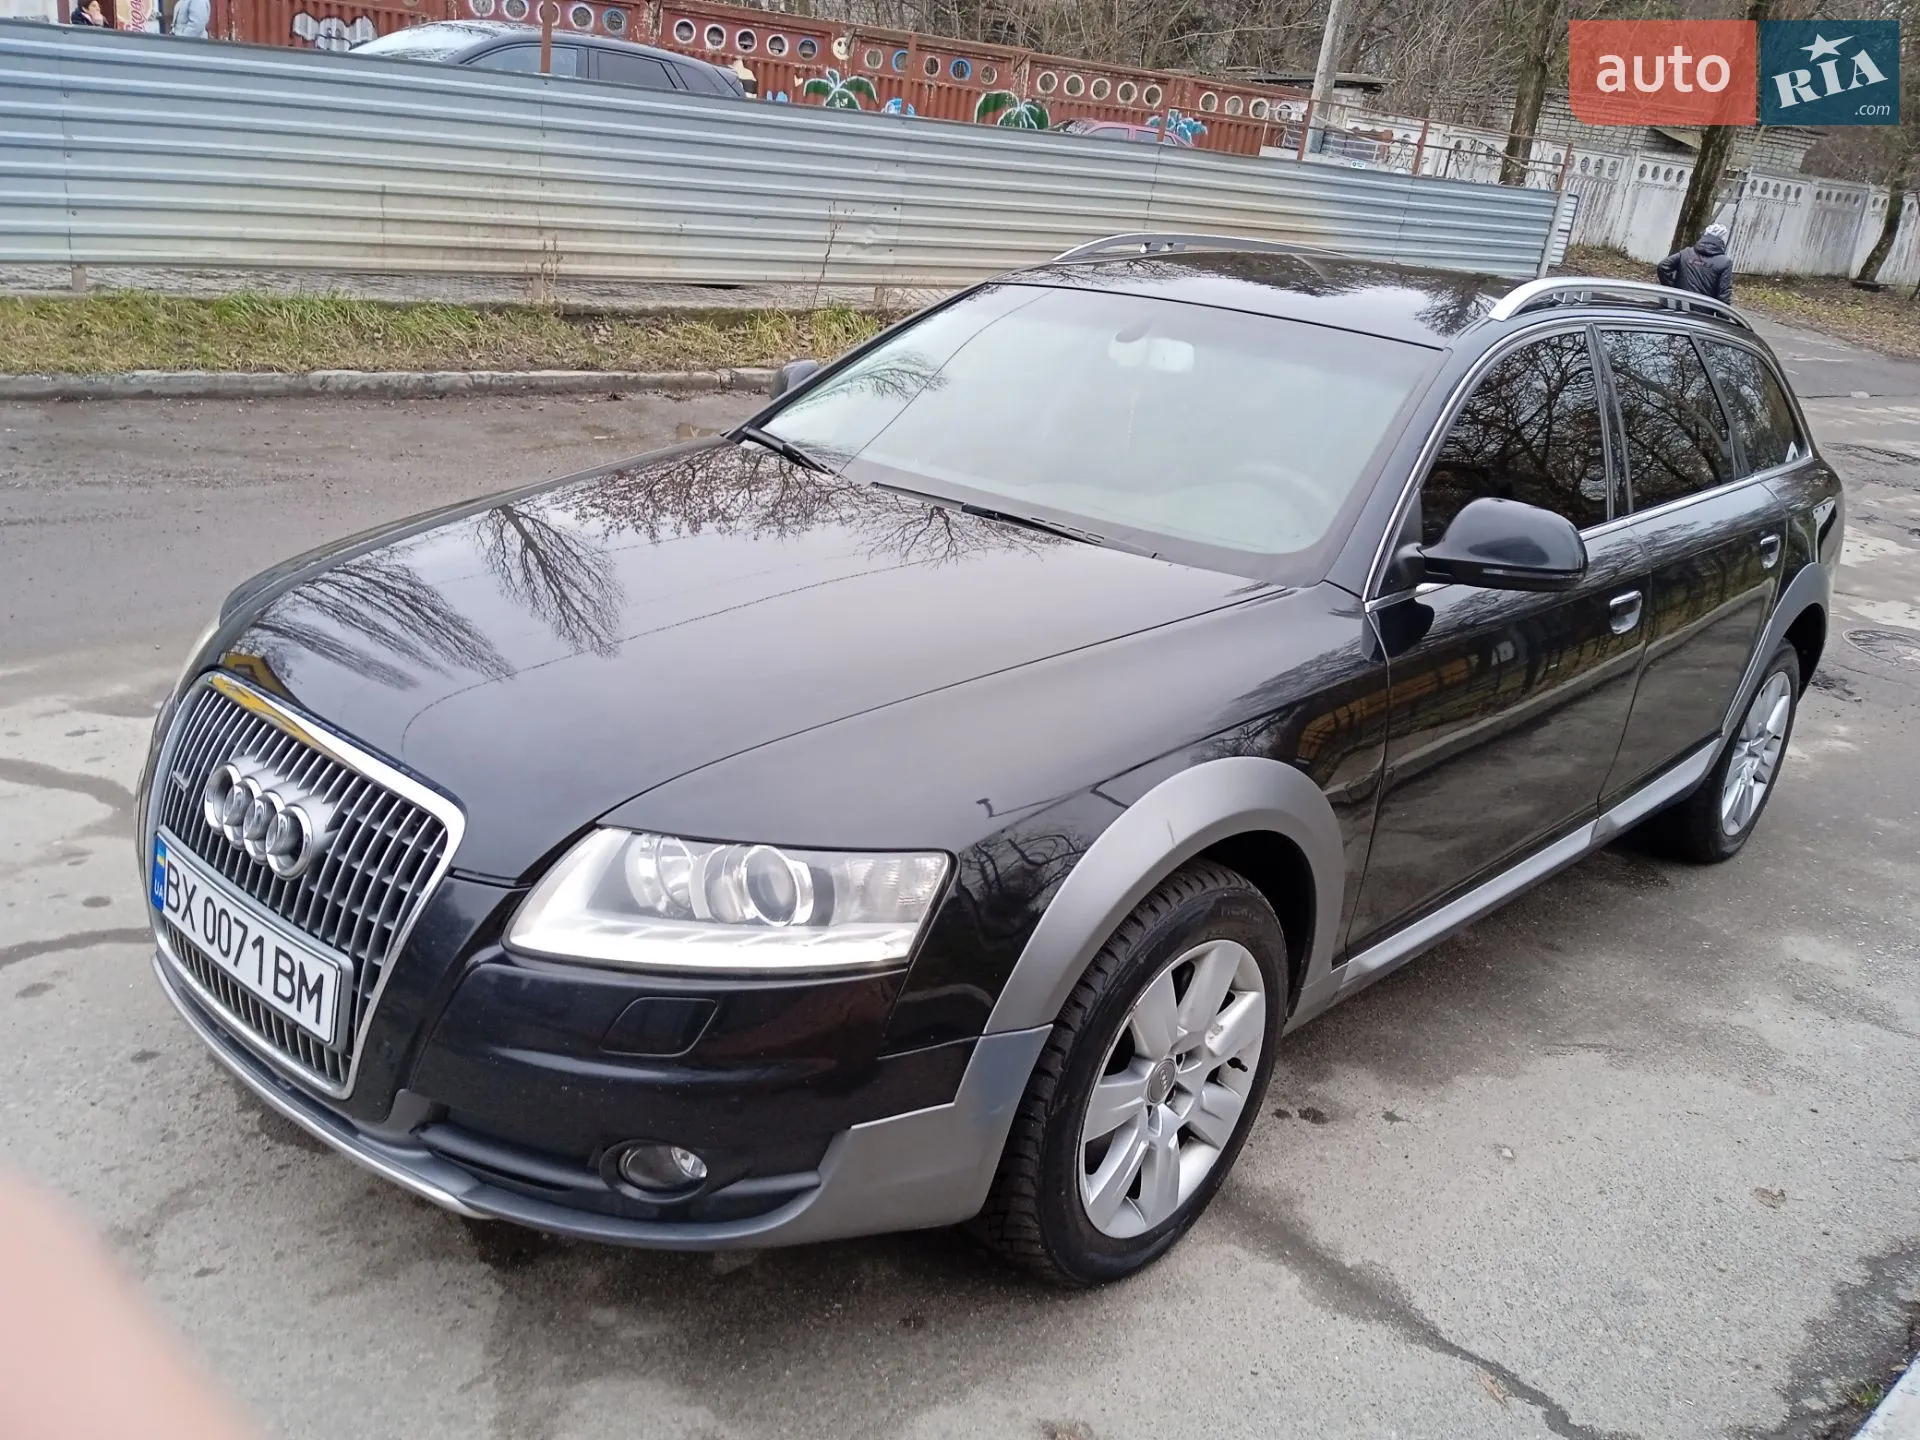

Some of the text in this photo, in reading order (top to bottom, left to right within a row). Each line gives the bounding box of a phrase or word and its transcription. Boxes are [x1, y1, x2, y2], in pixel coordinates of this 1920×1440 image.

[165, 860, 325, 1025] BX 0071 BM
